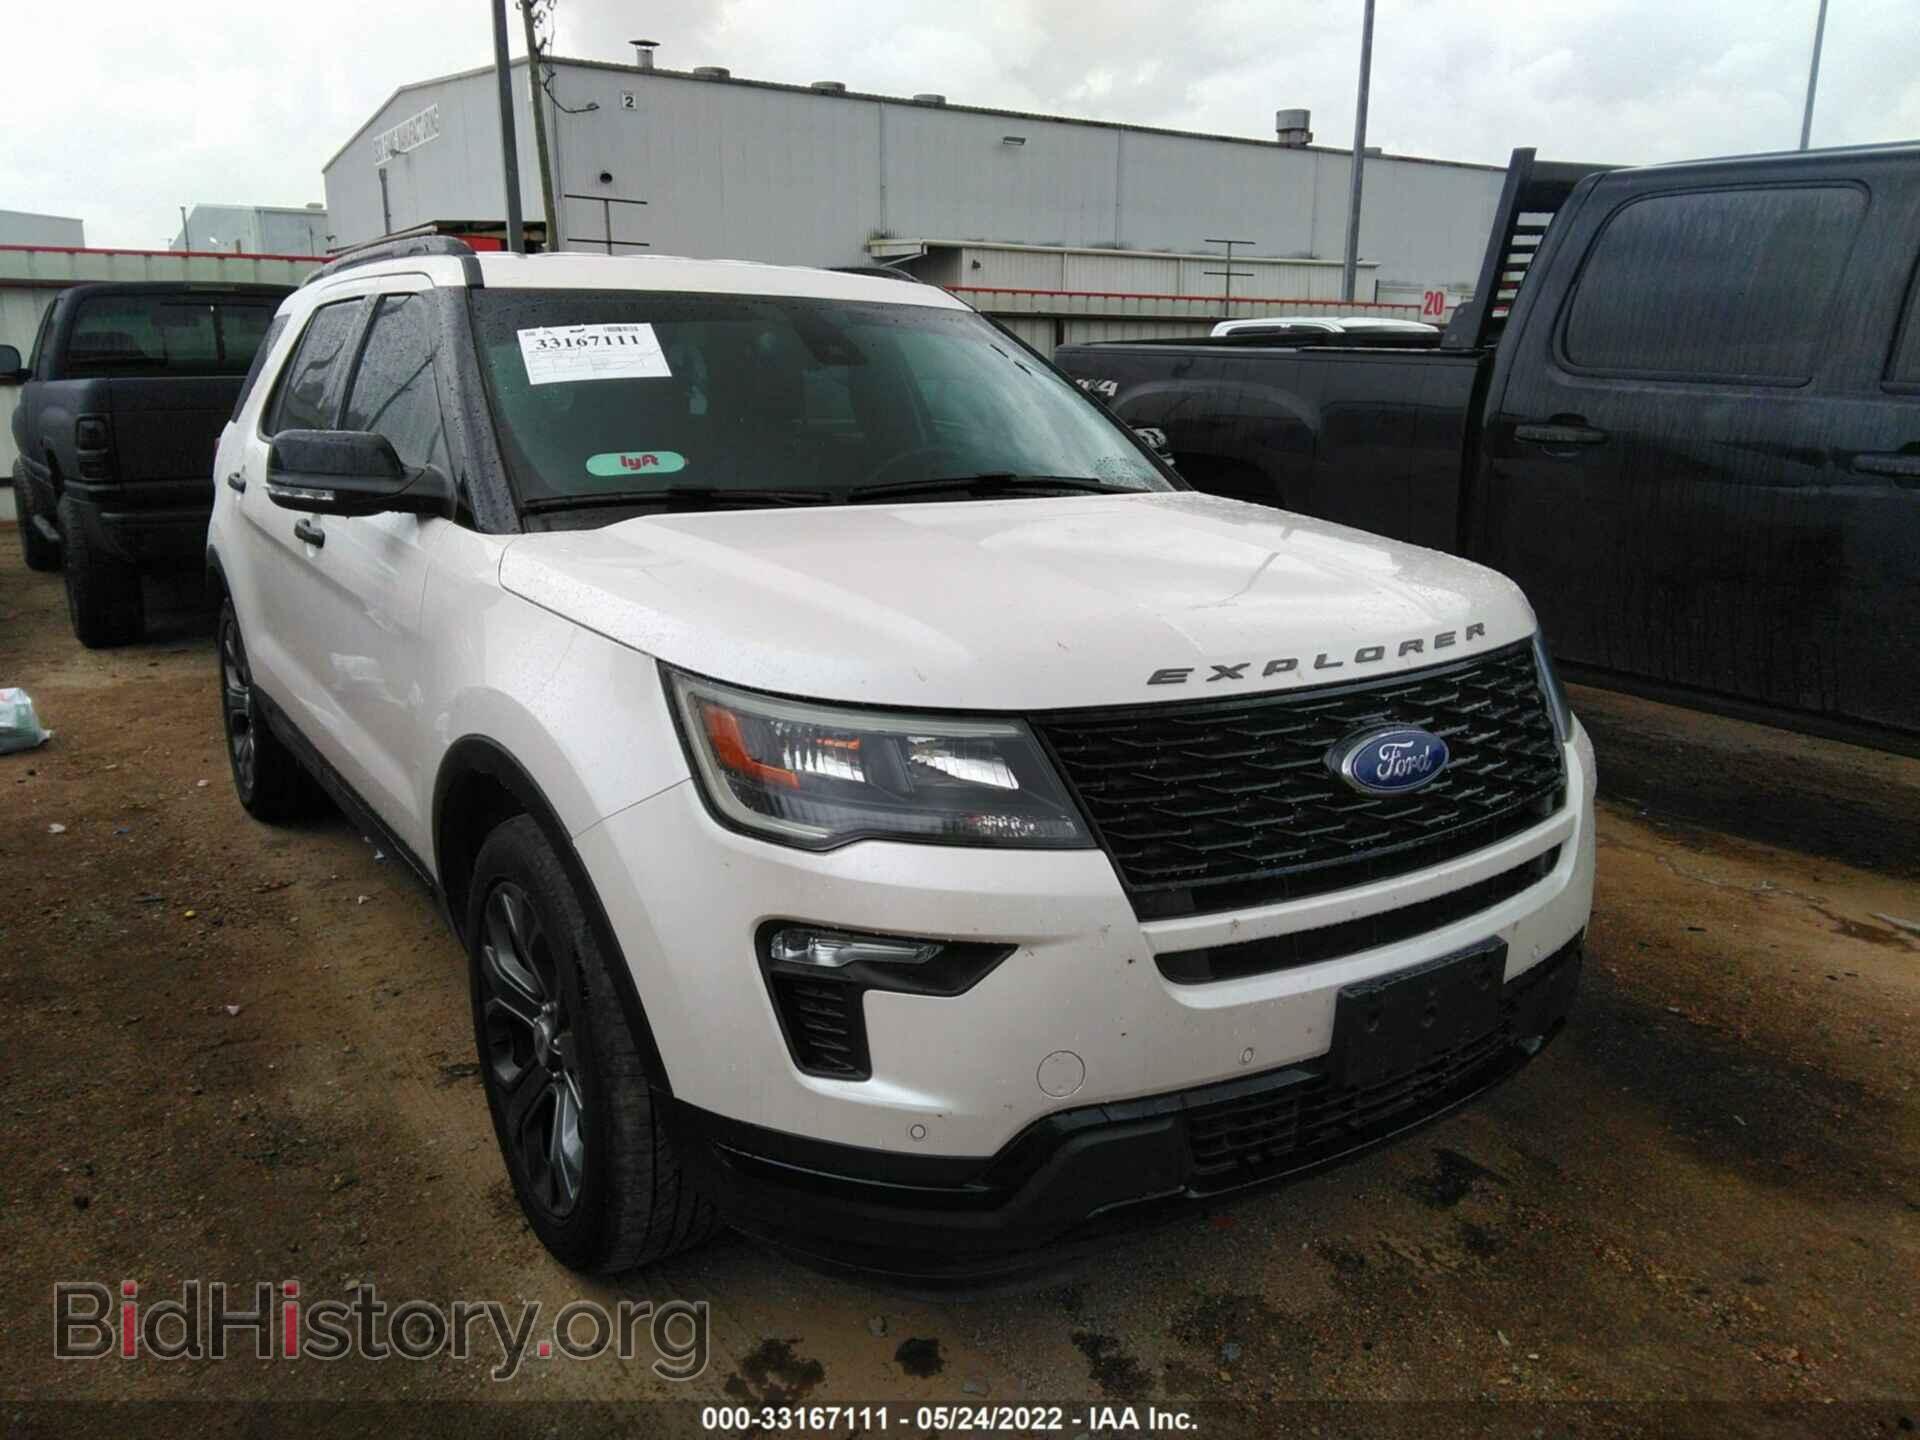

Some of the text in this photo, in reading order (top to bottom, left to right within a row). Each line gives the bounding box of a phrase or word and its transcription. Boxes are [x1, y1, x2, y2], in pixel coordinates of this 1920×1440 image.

[625, 96, 634, 108] 2
[1424, 290, 1444, 316] 20
[536, 334, 639, 350] 33167111
[1147, 621, 1486, 685] EXPLORER
[1376, 740, 1432, 780] Ford
